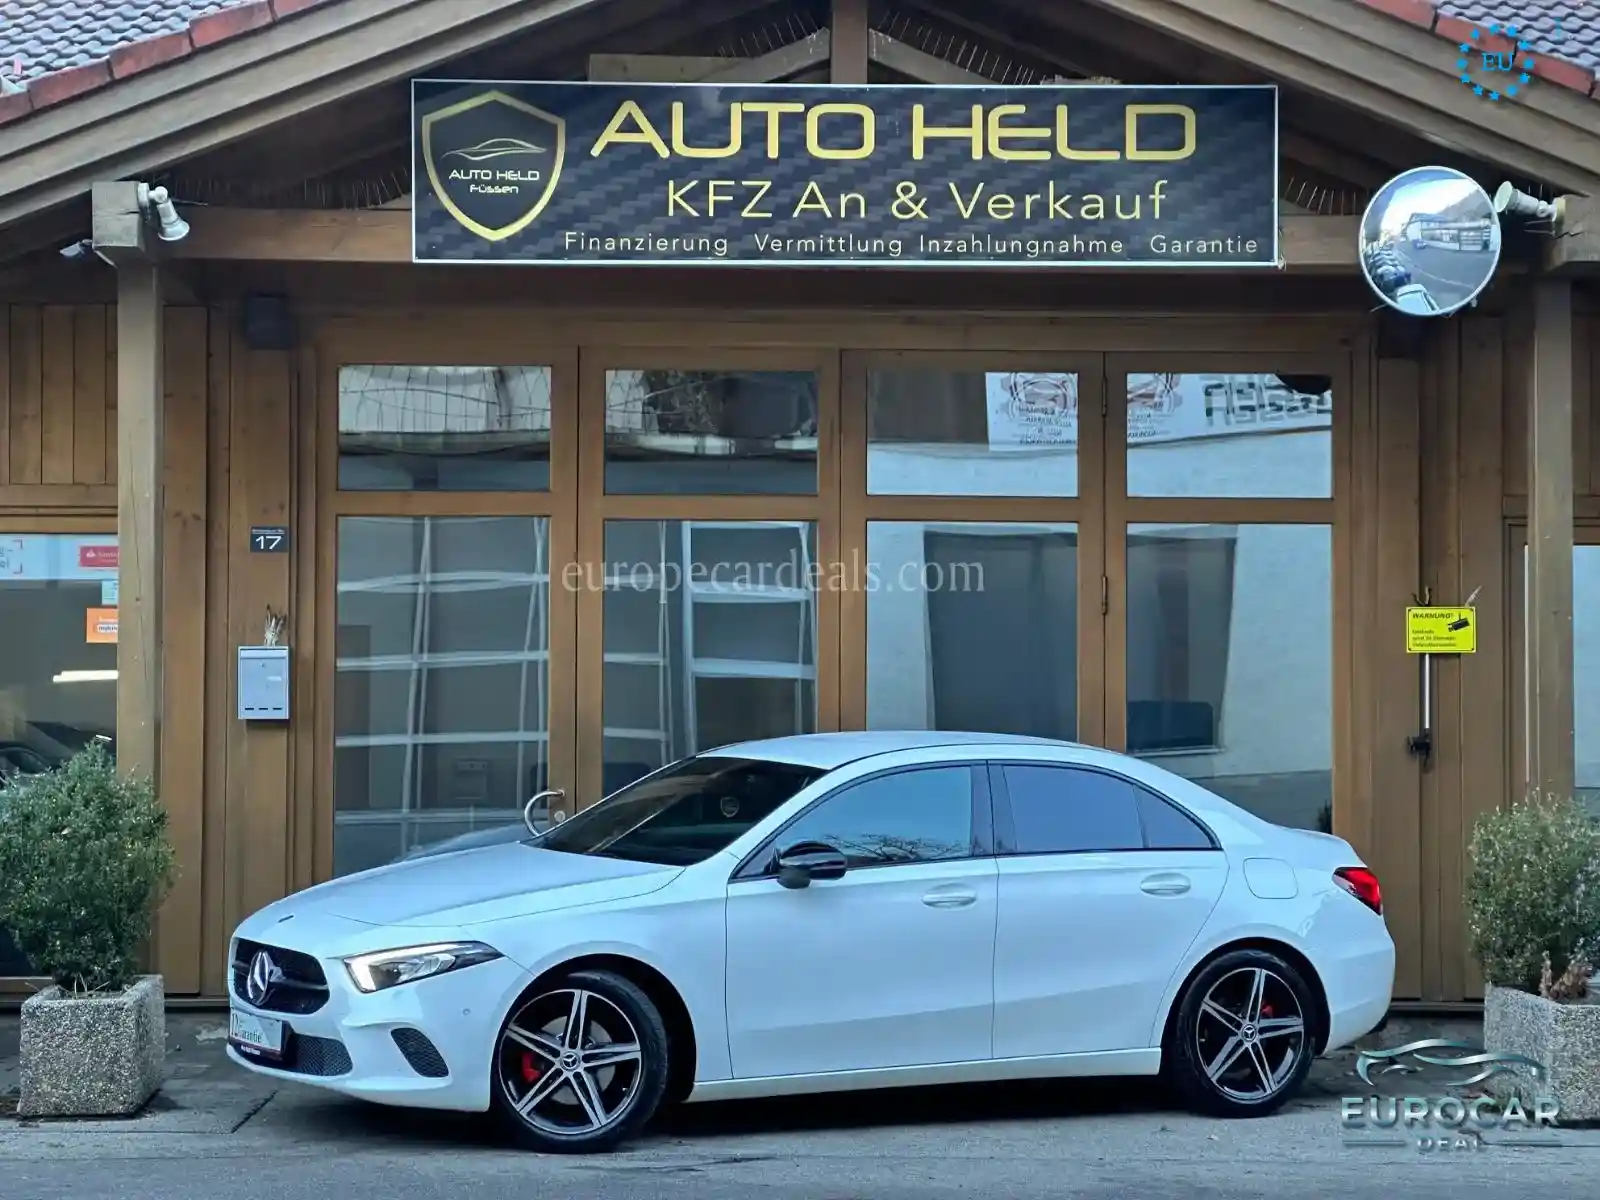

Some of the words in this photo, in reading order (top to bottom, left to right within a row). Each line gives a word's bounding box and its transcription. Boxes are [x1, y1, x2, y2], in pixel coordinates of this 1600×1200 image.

[590, 100, 876, 160] AUTO
[911, 103, 1197, 161] HELD
[448, 169, 492, 181] AUTO
[496, 170, 540, 181] HELD
[469, 183, 519, 195] Füssen
[667, 179, 773, 218] KFZ
[792, 181, 866, 219] An
[891, 180, 928, 220] &
[948, 179, 1168, 220] Verkauf
[564, 231, 729, 256] Finanzierung
[755, 233, 903, 256] Vermittlung
[919, 234, 1124, 256] Inzahlungnahme
[1149, 234, 1258, 254] Garantie
[255, 535, 282, 550] 17
